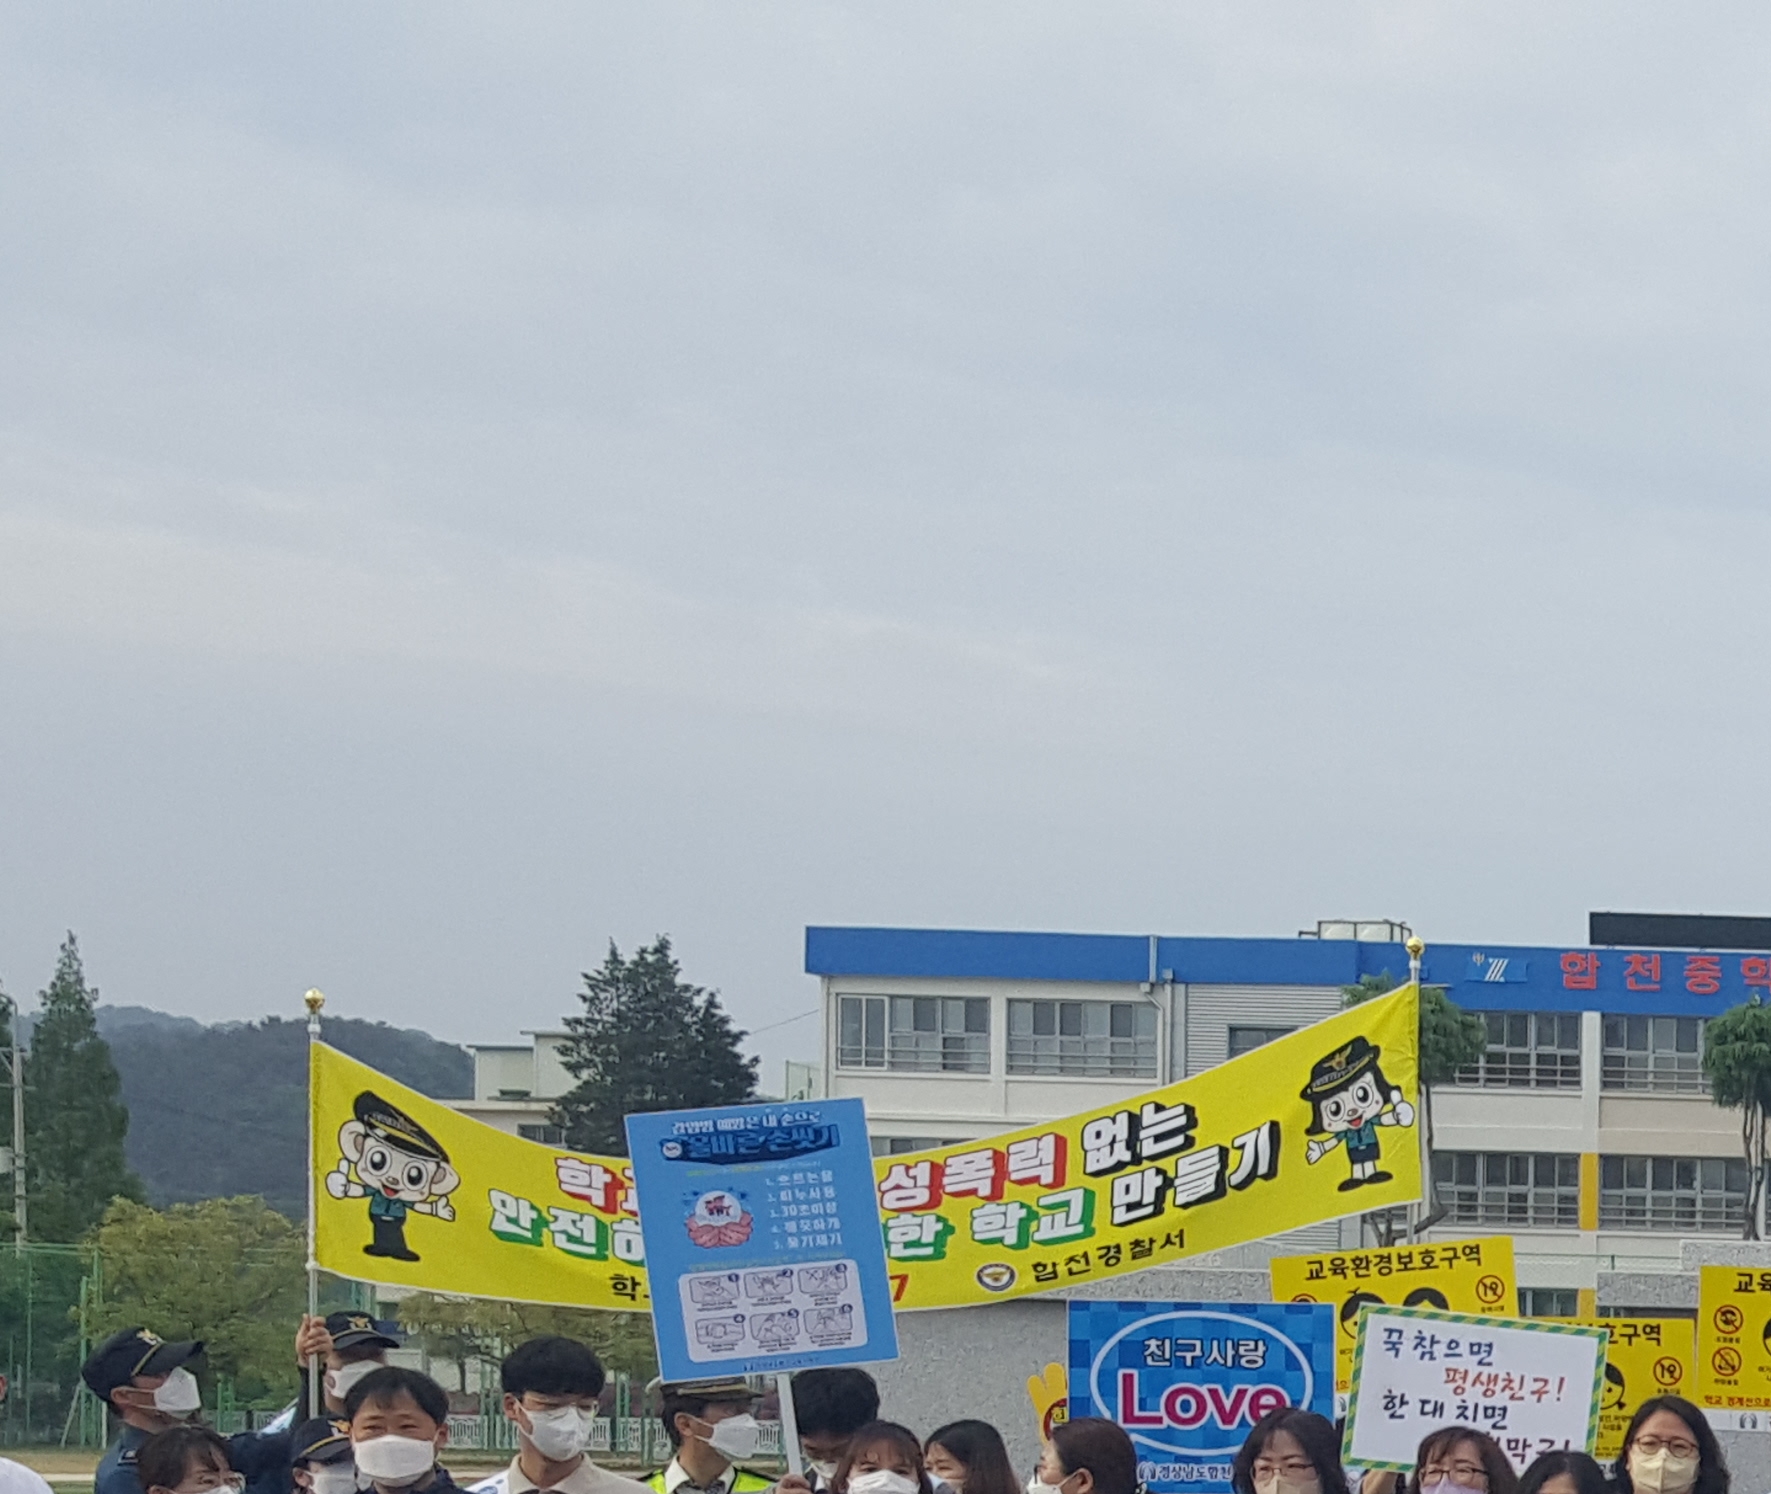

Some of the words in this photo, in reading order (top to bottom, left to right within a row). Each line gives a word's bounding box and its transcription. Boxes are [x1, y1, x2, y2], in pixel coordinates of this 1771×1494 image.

[878, 1132, 1068, 1211] 성폭력
[1081, 1101, 1199, 1176] 없는
[970, 1187, 1096, 1250] 학교
[1111, 1119, 1281, 1227] 만들기
[1305, 1243, 1482, 1282] 교육환경보호구역
[1143, 1337, 1268, 1370] 친구사랑
[1382, 1327, 1405, 1359] 꾹
[1412, 1330, 1494, 1367] 참으면
[1119, 1370, 1290, 1428] Love
[1443, 1367, 1566, 1404] 평생친구!
[1382, 1389, 1410, 1420] 한
[1418, 1398, 1444, 1419] 대
[1454, 1399, 1509, 1431] 치면
[1157, 1463, 1235, 1482] 경상남도합천
